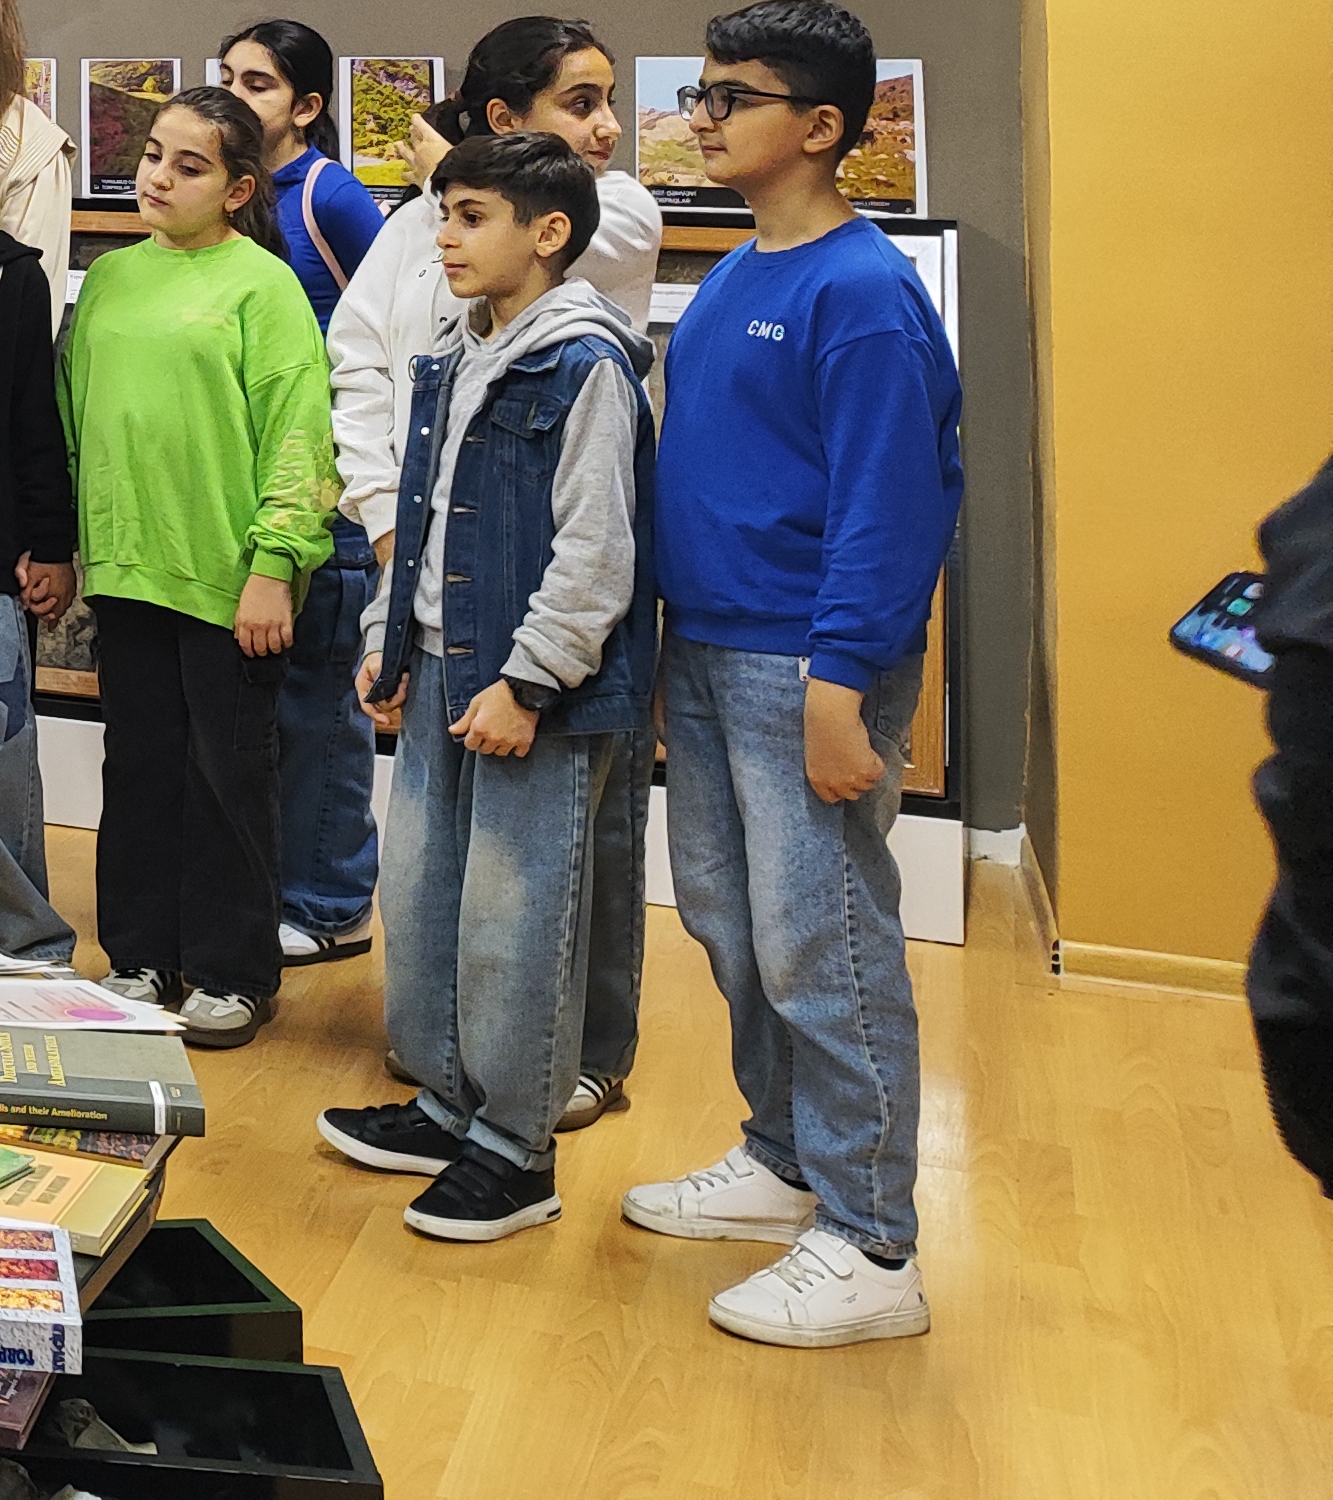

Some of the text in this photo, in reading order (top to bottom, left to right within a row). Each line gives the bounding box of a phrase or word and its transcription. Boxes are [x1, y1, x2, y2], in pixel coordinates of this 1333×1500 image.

[747, 319, 785, 341] CMG
[10, 1104, 27, 1114] and
[28, 1105, 50, 1116] their
[50, 1107, 108, 1121] Amelioration
